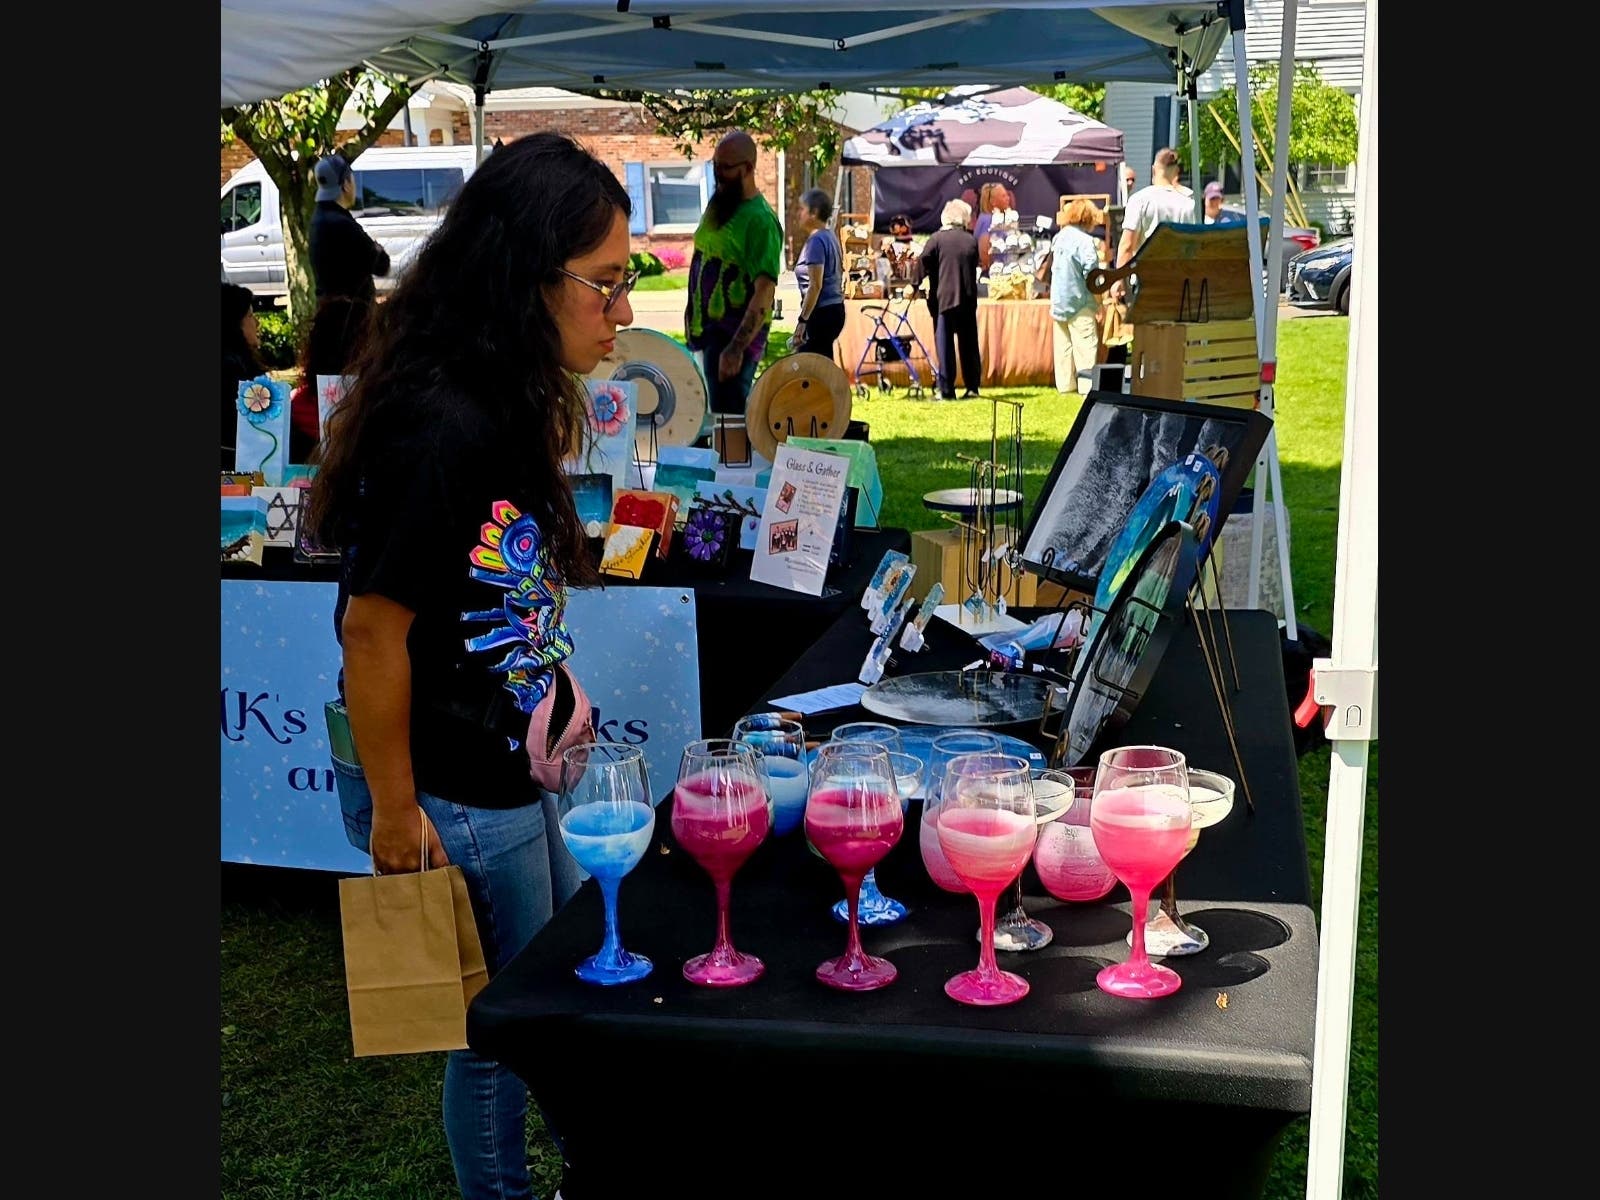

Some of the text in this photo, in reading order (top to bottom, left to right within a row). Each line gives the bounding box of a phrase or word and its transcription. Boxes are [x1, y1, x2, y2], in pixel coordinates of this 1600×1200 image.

[976, 168, 1018, 186] BOUTIQUE
[786, 457, 841, 478] Glass & Gather
[591, 706, 649, 745] ks
